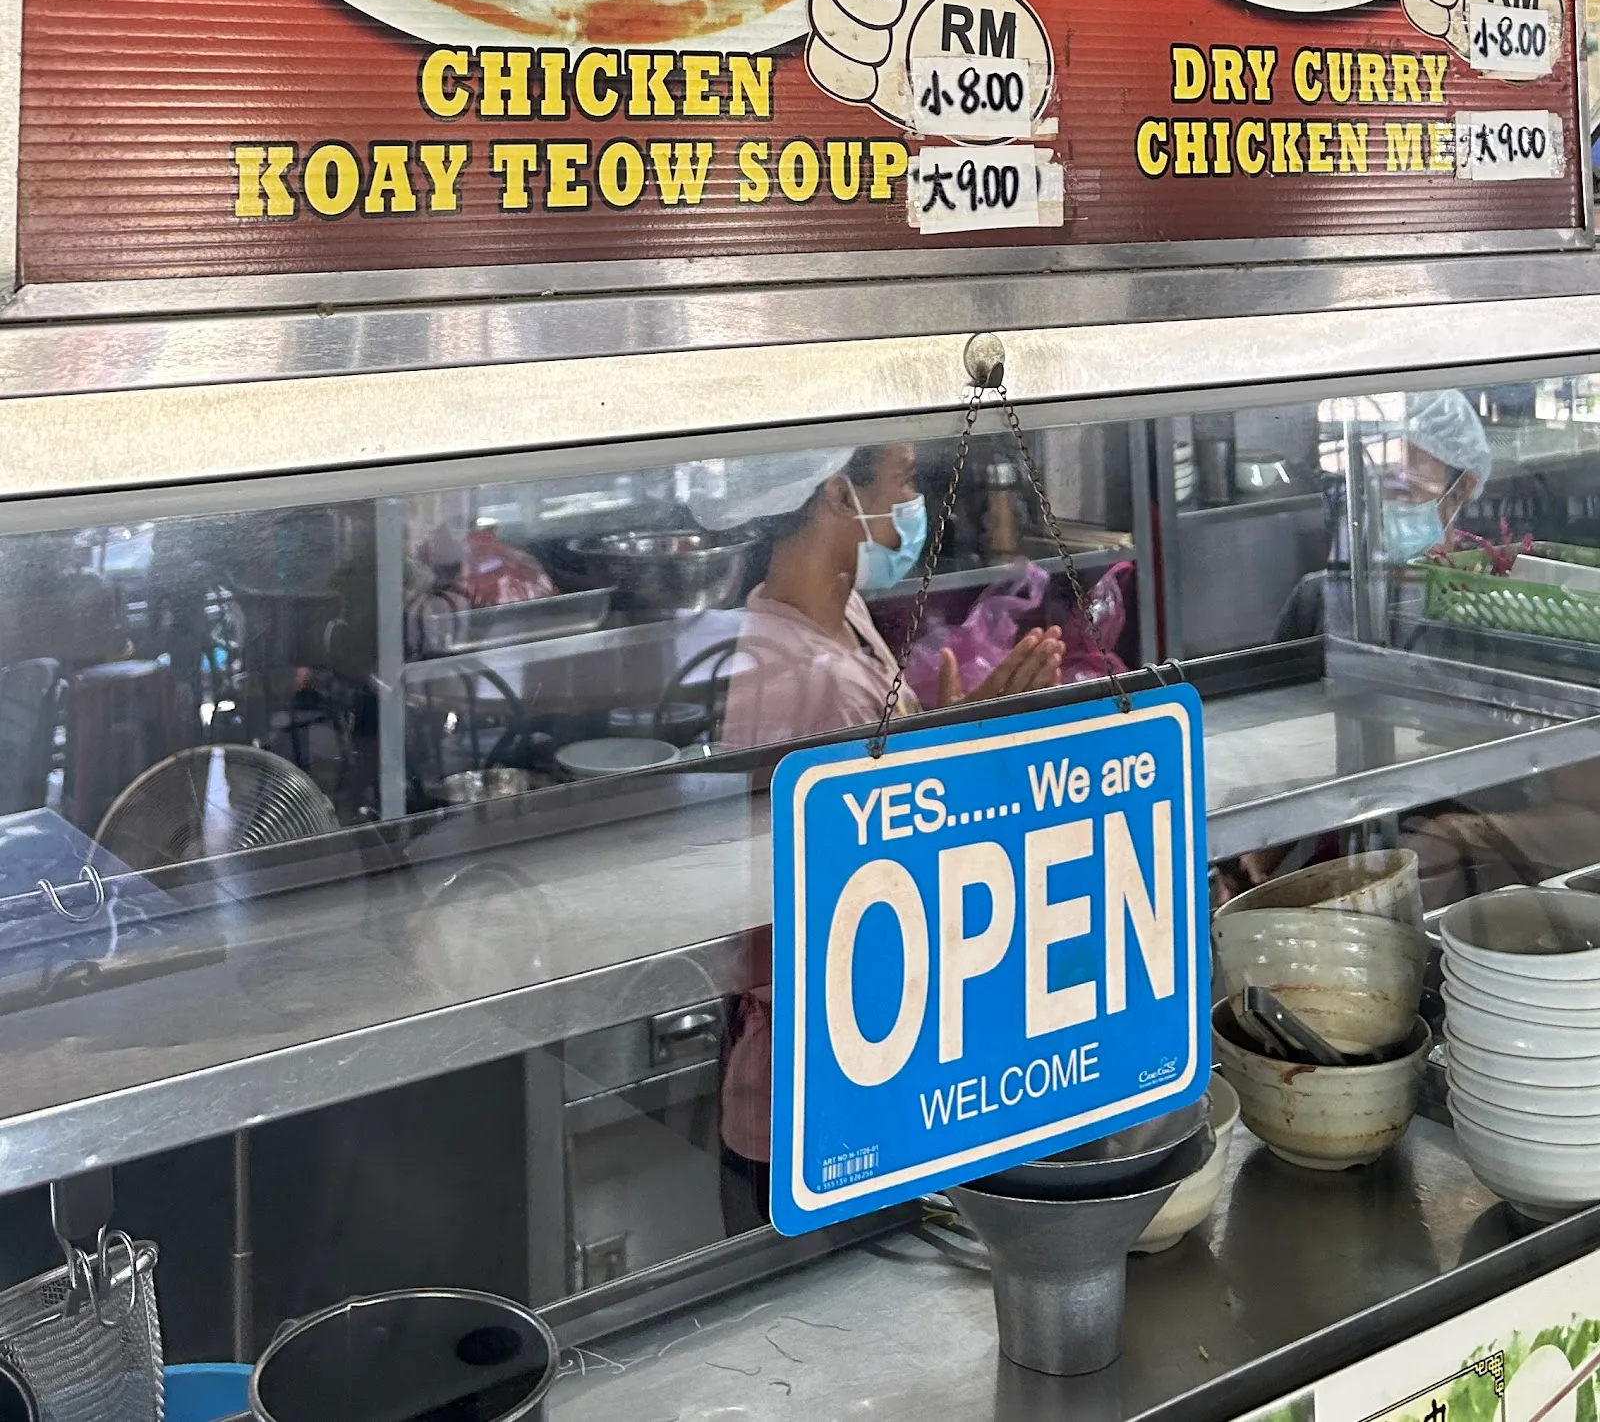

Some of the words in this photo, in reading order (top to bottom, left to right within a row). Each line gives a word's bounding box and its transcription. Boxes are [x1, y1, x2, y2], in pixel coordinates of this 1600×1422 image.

[941, 3, 1016, 59] RM
[420, 48, 773, 118] CHICKEN
[1171, 48, 1276, 101] DRY
[1294, 51, 1449, 104] CURRY
[234, 143, 468, 217] KOAY
[493, 141, 714, 208] TEOW
[738, 140, 909, 203] SOUP
[1137, 120, 1370, 176] CHICKEN
[1028, 757, 1091, 811] We
[1101, 751, 1156, 797] are
[825, 799, 1175, 1087] OPEN
[919, 1042, 1100, 1130] WELCOME
